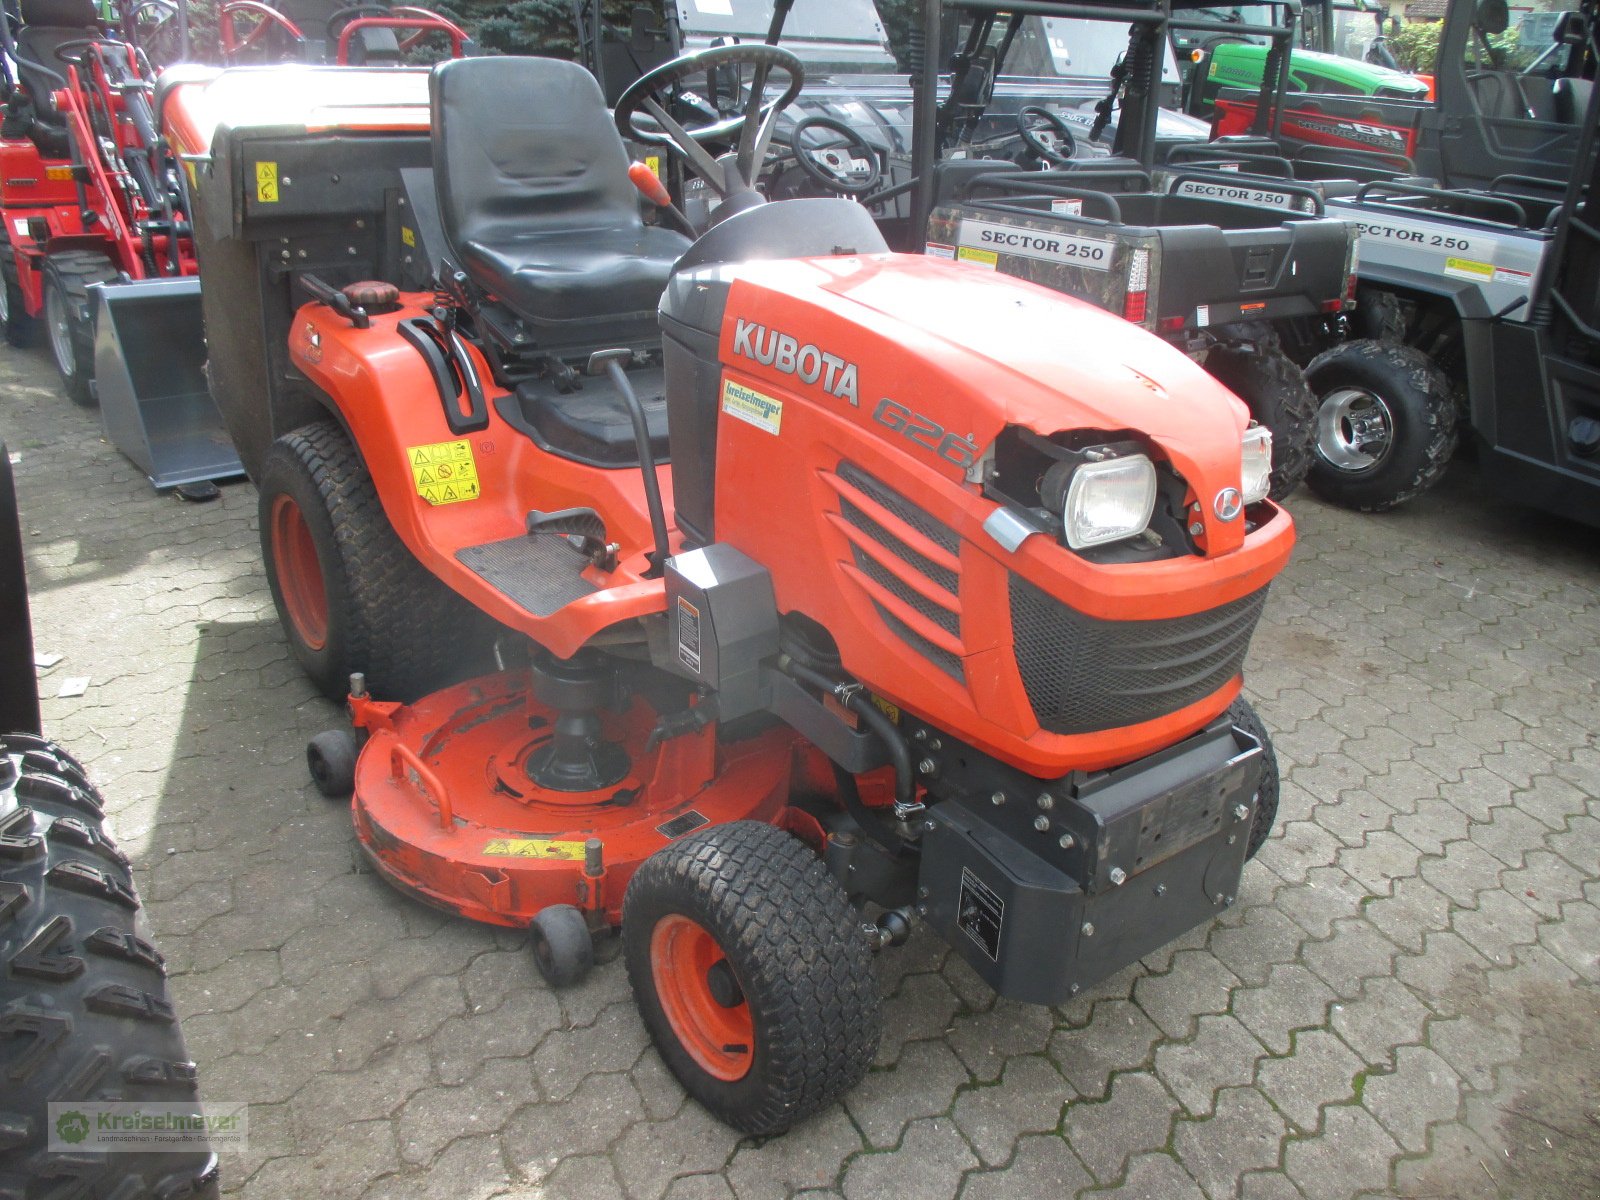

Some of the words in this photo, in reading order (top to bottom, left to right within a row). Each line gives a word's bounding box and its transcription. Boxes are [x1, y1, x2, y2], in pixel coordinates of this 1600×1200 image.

[1184, 184, 1249, 200] SECTOR
[1253, 192, 1284, 204] 250
[981, 230, 1060, 253] SECTOR
[1065, 243, 1104, 261] 250
[1355, 222, 1425, 243] ECTOR
[1429, 235, 1470, 251] 250
[733, 318, 860, 408] KUBOTA
[871, 397, 980, 469] G26
